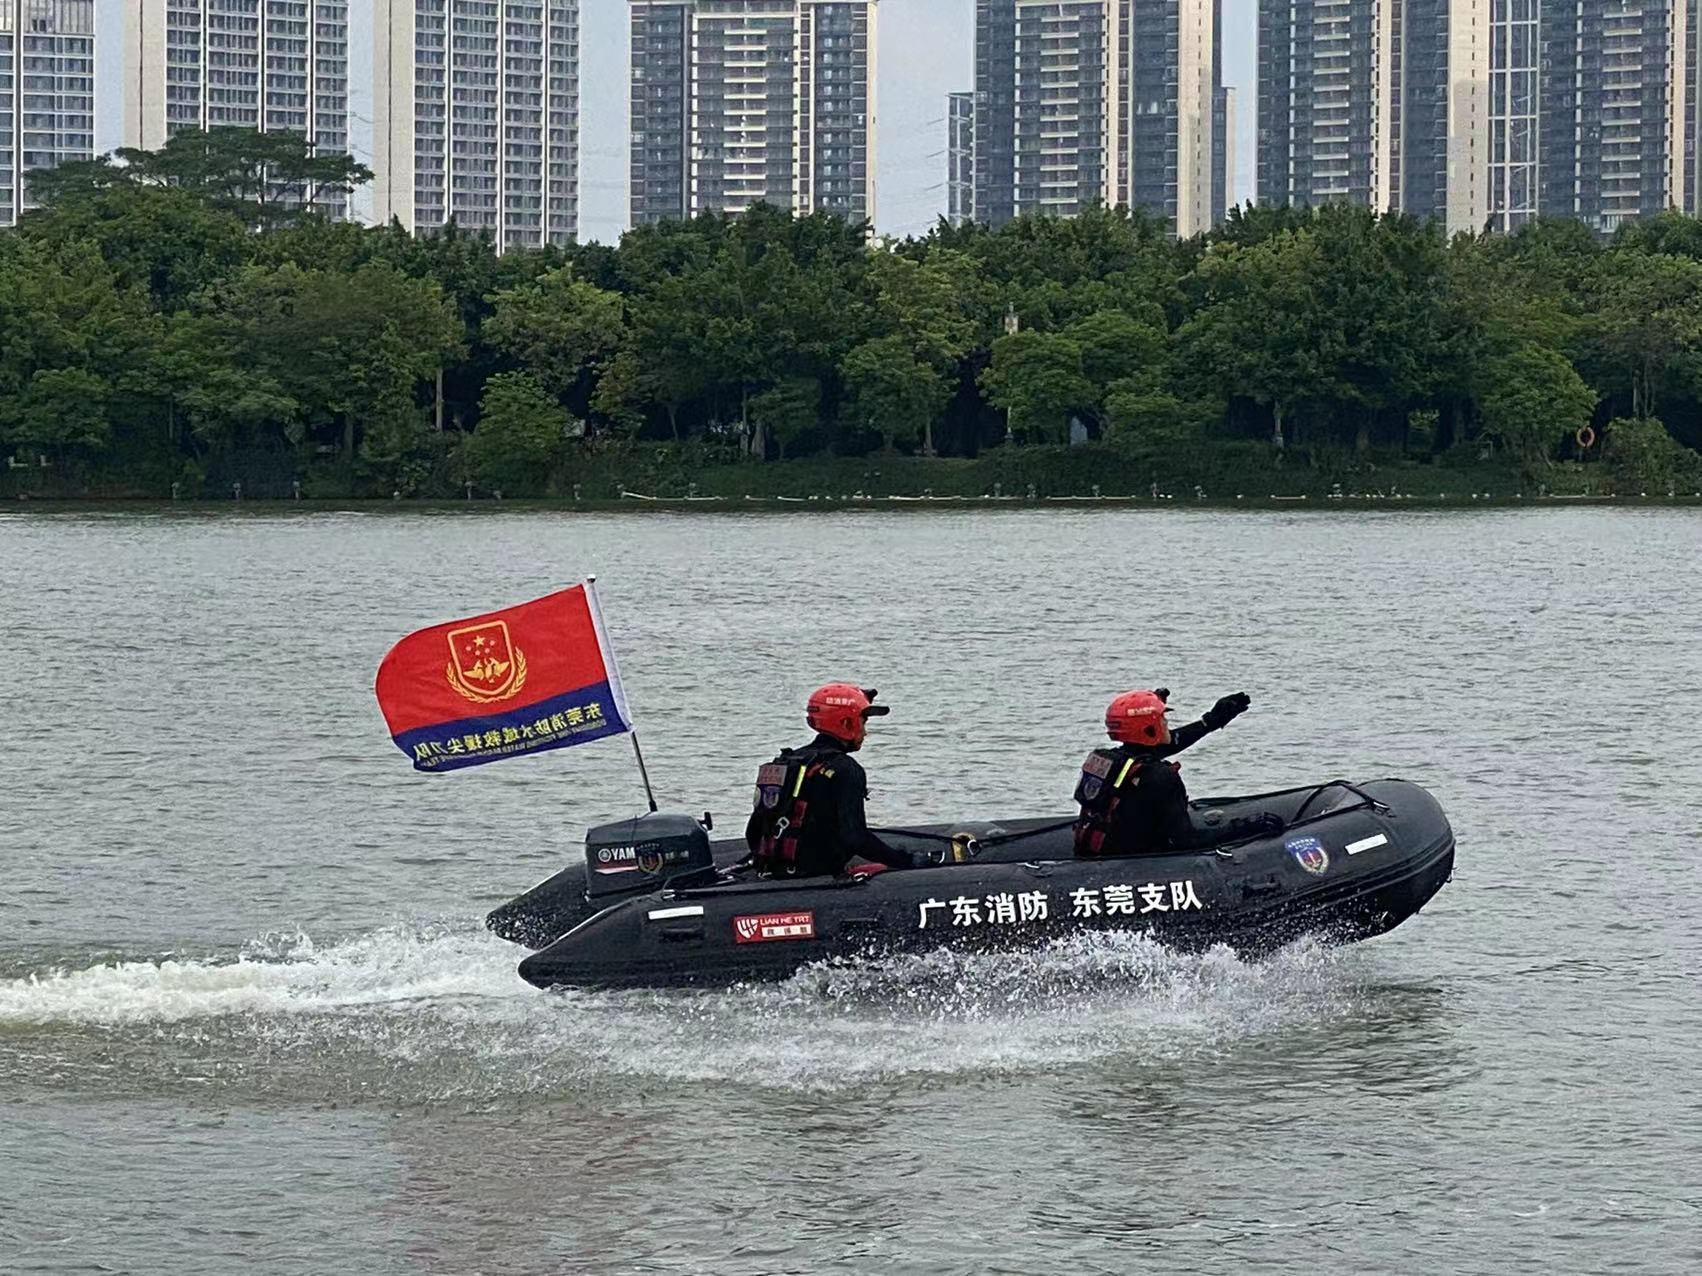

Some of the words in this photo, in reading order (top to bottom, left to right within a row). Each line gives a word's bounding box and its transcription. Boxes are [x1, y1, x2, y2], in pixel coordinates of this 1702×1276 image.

[918, 891, 1048, 928] 广东消防
[1069, 880, 1202, 918] 东莞支队
[760, 917, 779, 925] LIAN
